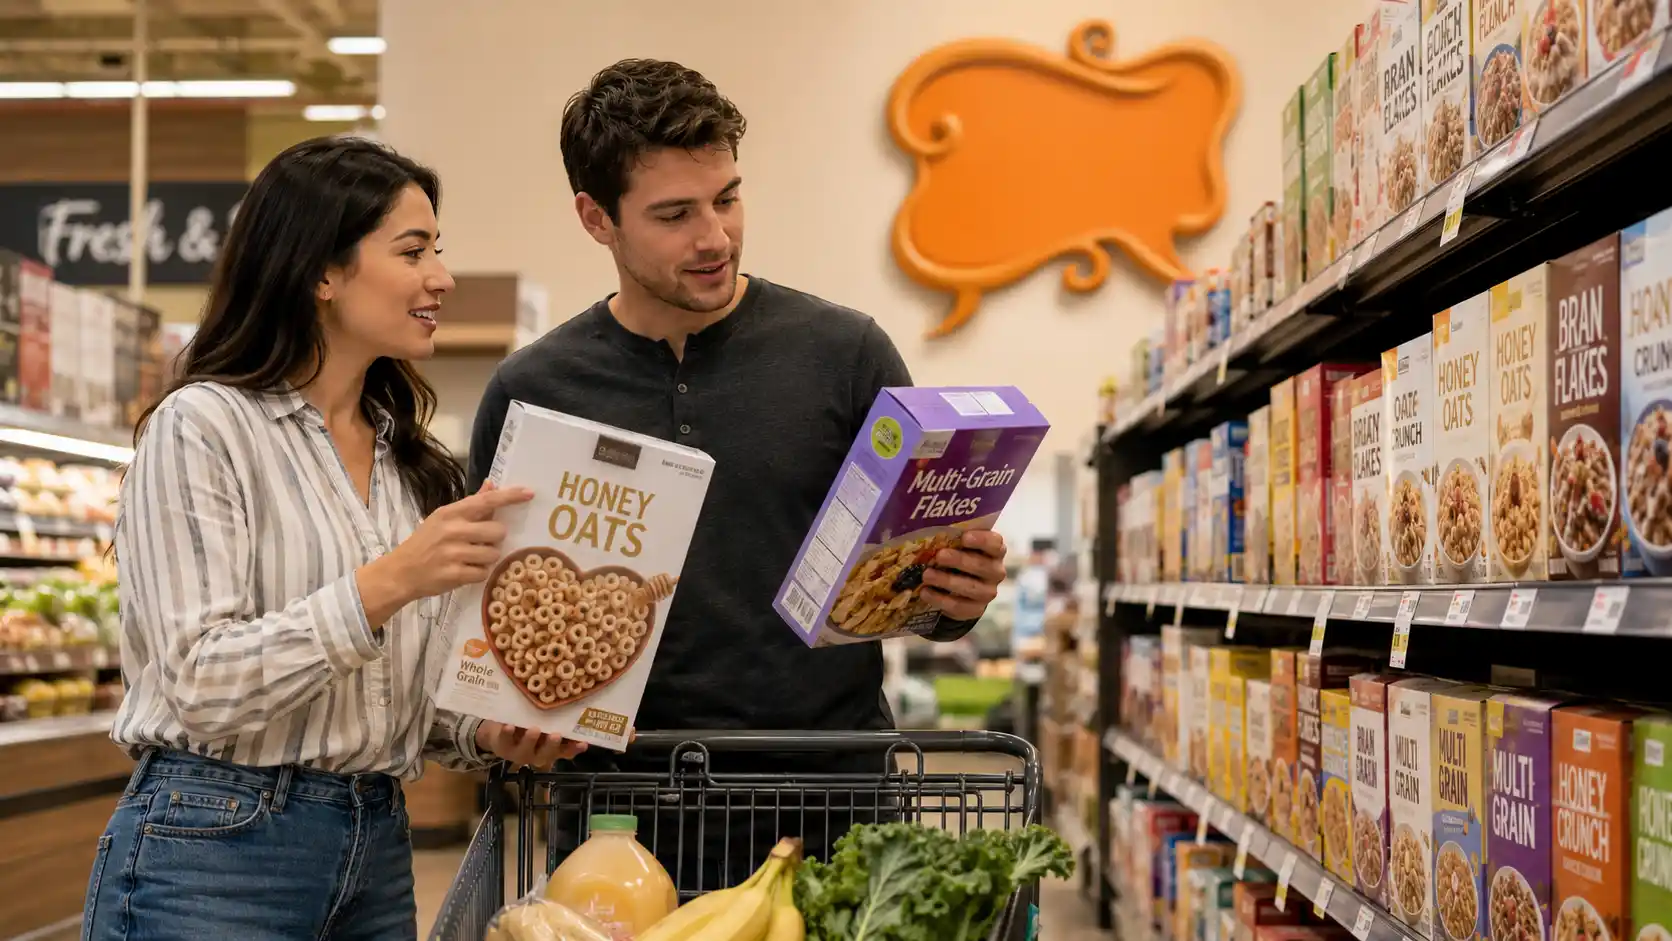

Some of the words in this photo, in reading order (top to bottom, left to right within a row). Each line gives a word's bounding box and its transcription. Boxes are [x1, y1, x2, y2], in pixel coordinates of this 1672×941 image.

[178, 206, 221, 263] &
[1558, 285, 1604, 352] BRAN
[1497, 322, 1536, 368] HONEY
[1438, 351, 1480, 396] HONEY
[1500, 364, 1532, 406] OATS
[1554, 345, 1609, 406] FLAKES
[1443, 392, 1474, 432] OATS
[556, 471, 656, 520] HONEY
[907, 463, 1016, 494] Multi-Grain
[909, 495, 982, 520] Flakes
[548, 503, 648, 559] OATS
[456, 670, 485, 687] Grain
[460, 659, 494, 677] Whole
[1438, 727, 1467, 769] MULTI
[1438, 765, 1468, 808] GRAIN
[1558, 762, 1608, 817] HONEY
[1492, 797, 1536, 850] GRAIN
[1556, 808, 1610, 863] CRUNCH
